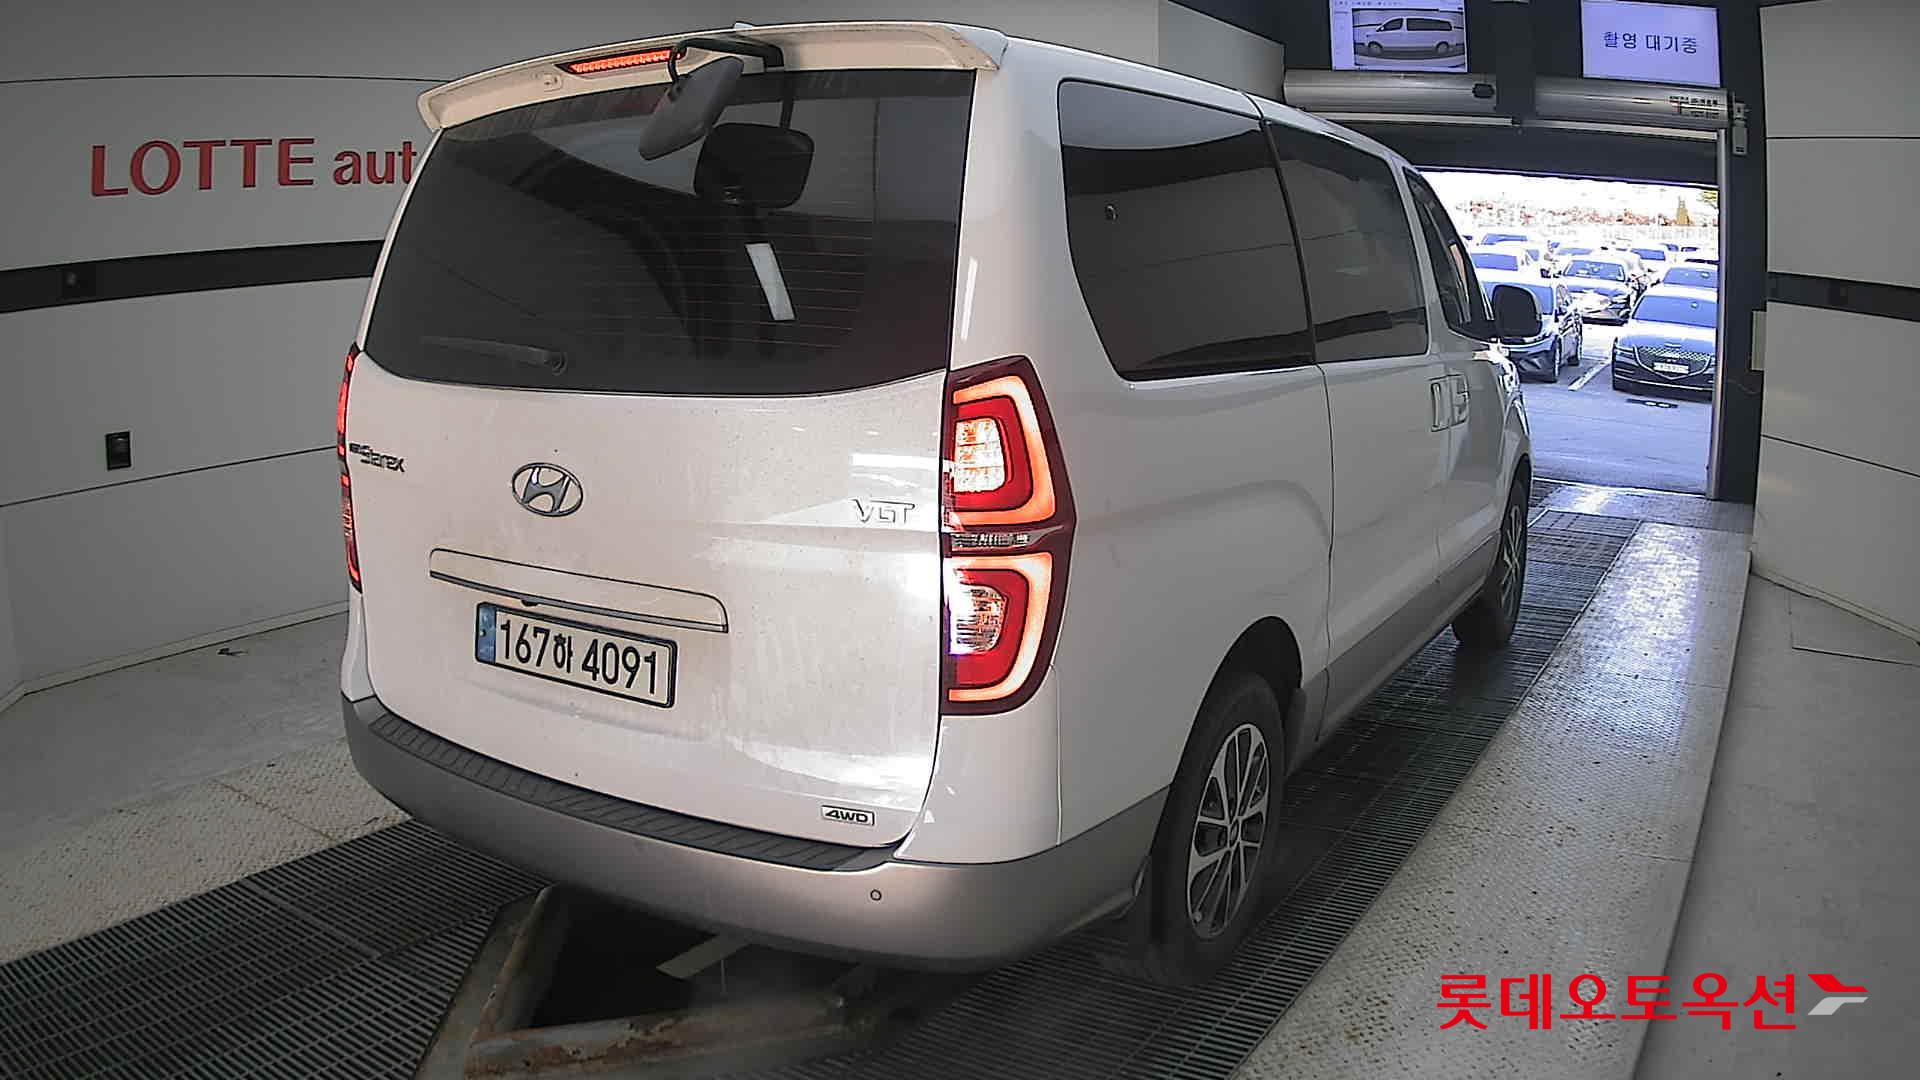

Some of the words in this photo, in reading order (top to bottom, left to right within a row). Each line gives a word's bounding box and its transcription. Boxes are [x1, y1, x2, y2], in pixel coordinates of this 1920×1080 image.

[1645, 34, 1697, 54] 대기중
[91, 138, 315, 197] LOTTE
[852, 498, 916, 524] VGT
[500, 619, 573, 674] 167하
[582, 638, 657, 695] 4091
[825, 809, 869, 823] 4WD
